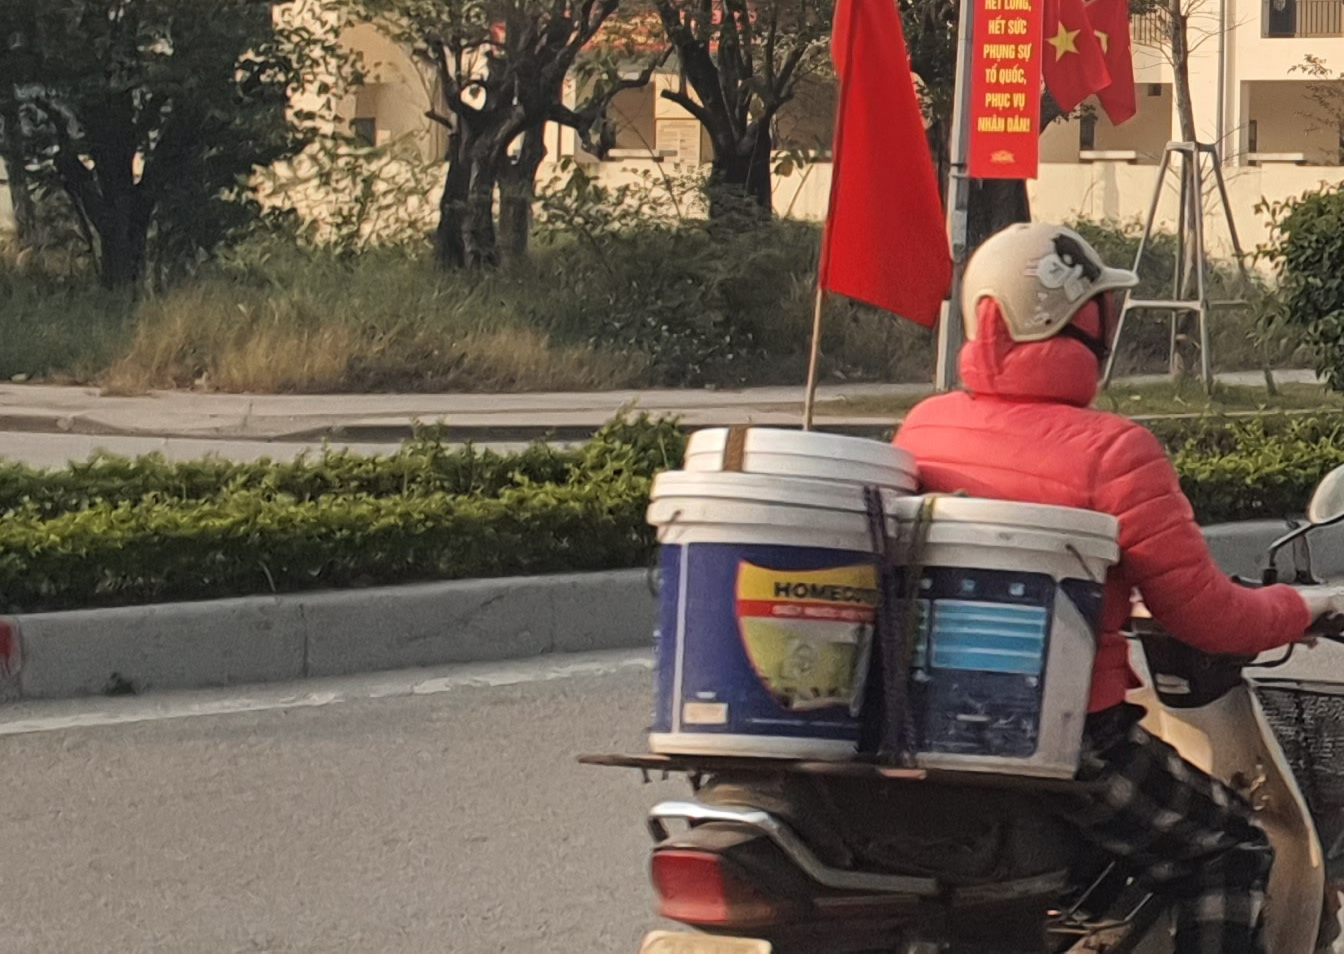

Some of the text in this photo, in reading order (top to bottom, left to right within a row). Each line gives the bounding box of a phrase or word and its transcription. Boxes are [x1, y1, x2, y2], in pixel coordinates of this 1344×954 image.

[988, 15, 1027, 35] HẾT SỨC
[983, 42, 1033, 63] PHỤNG SỰ
[999, 63, 1027, 85] QUỐC,
[985, 92, 1026, 111] PHỤC VỤ
[977, 114, 1005, 132] NHÂN
